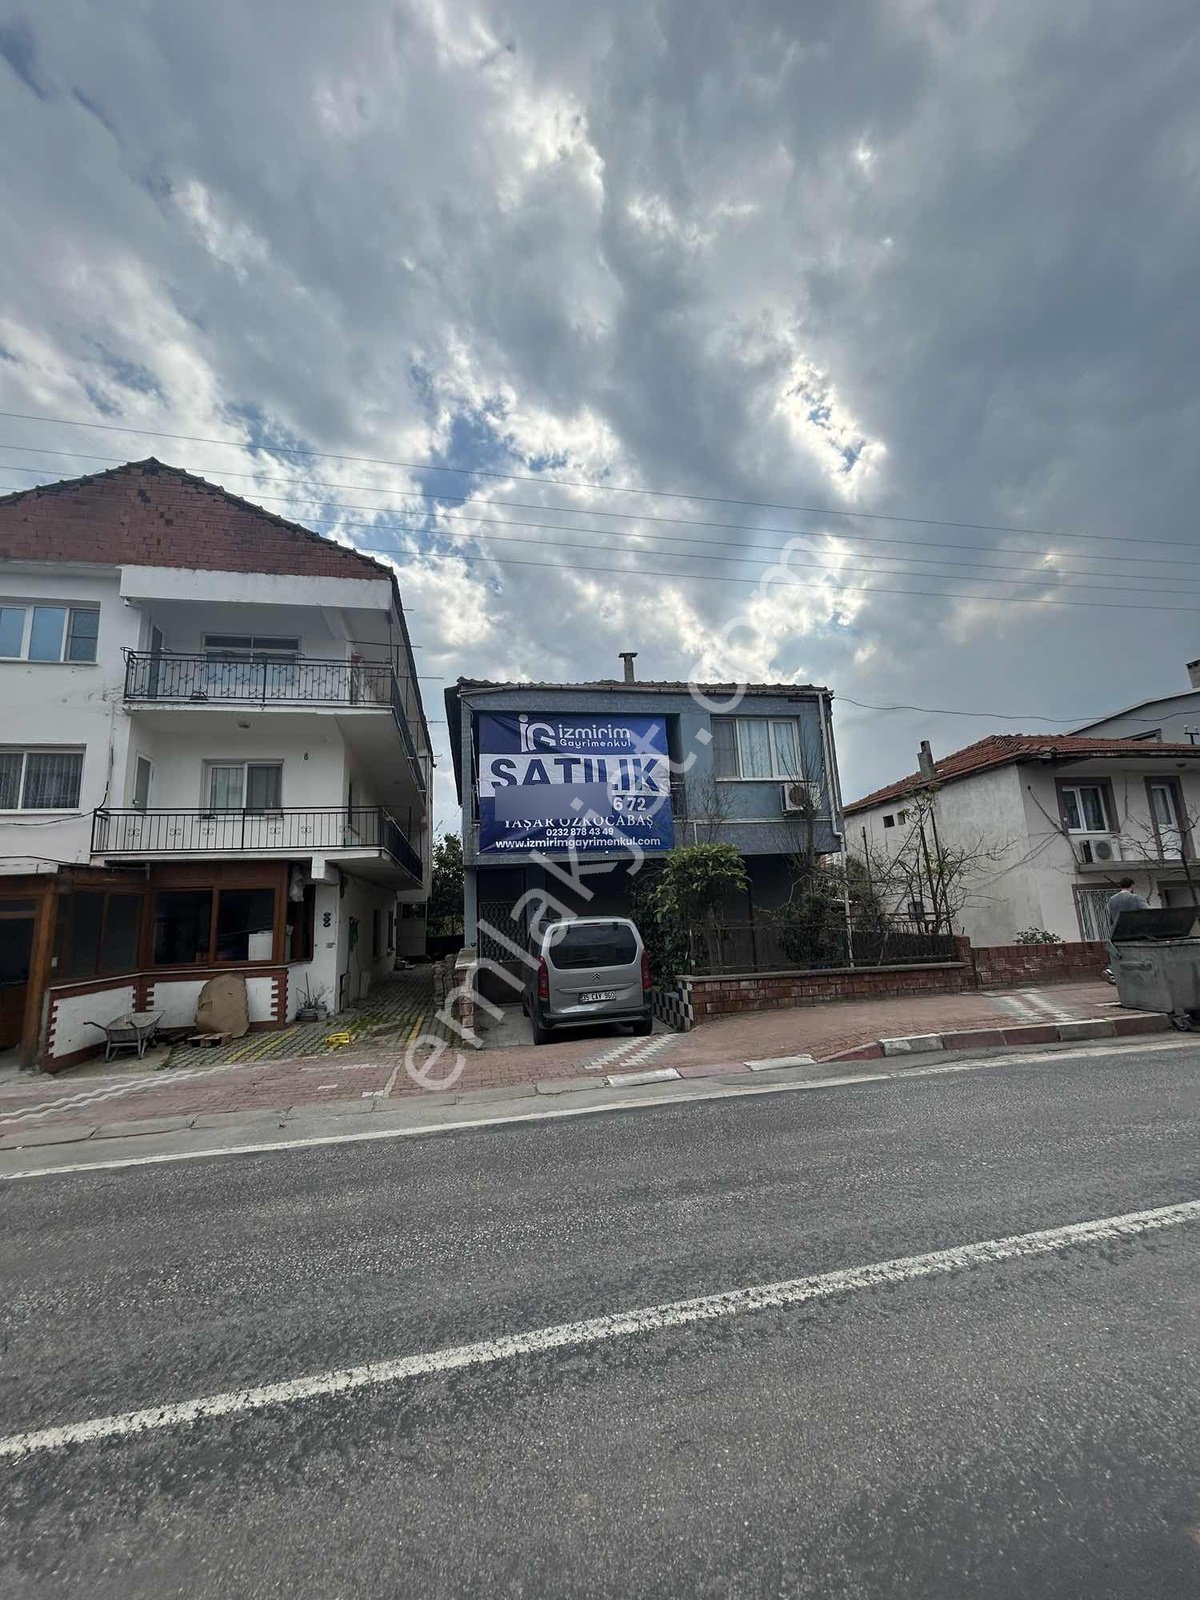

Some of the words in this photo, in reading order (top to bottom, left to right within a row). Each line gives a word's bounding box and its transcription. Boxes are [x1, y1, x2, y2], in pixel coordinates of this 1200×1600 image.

[558, 724, 631, 739] izmirim
[560, 739, 631, 749] Gayrimenkul
[490, 758, 661, 791] SATILIK
[546, 828, 569, 836] 0232
[570, 828, 587, 836] 878
[495, 837, 661, 849] www.izmirimgayrimenkul.com
